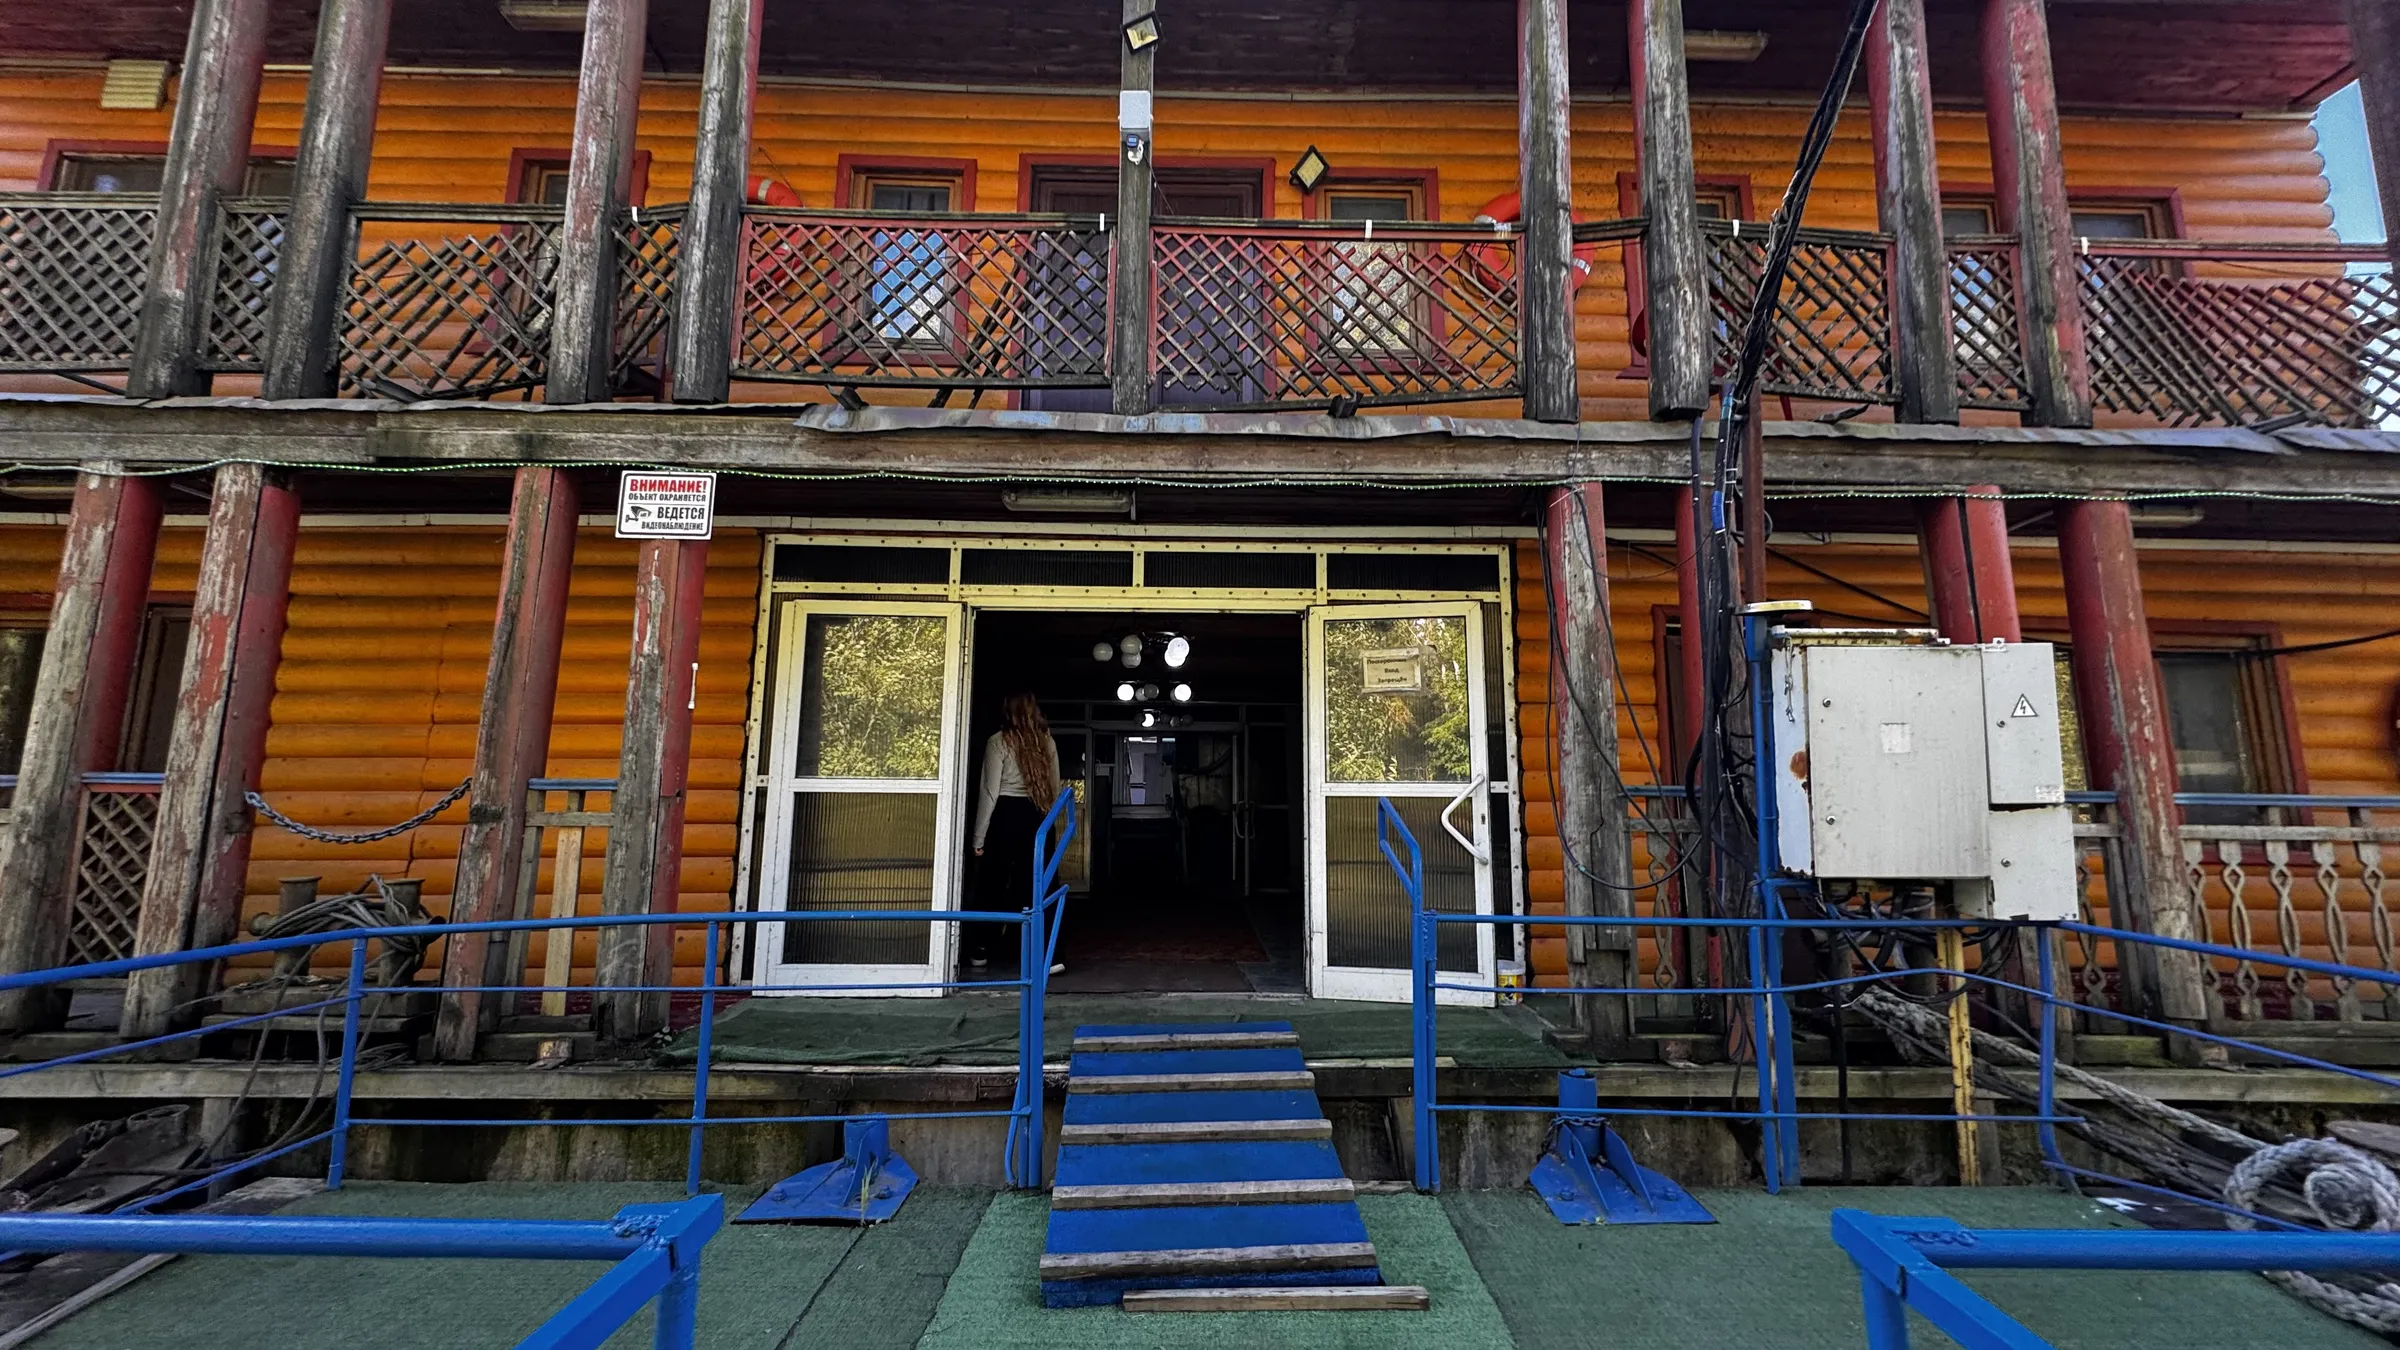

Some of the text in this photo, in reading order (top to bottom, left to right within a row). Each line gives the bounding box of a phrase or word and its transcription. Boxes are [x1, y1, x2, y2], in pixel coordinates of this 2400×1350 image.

[630, 479, 707, 493] ВНИМАНИЕ!
[628, 493, 706, 502] ОБЪЕКТ ОХРАНЯЕТСЯ
[657, 506, 705, 520] ВЕДЕТСЯ
[641, 521, 704, 531] ВИДЕОНАБЛЮДЕНИЕ
